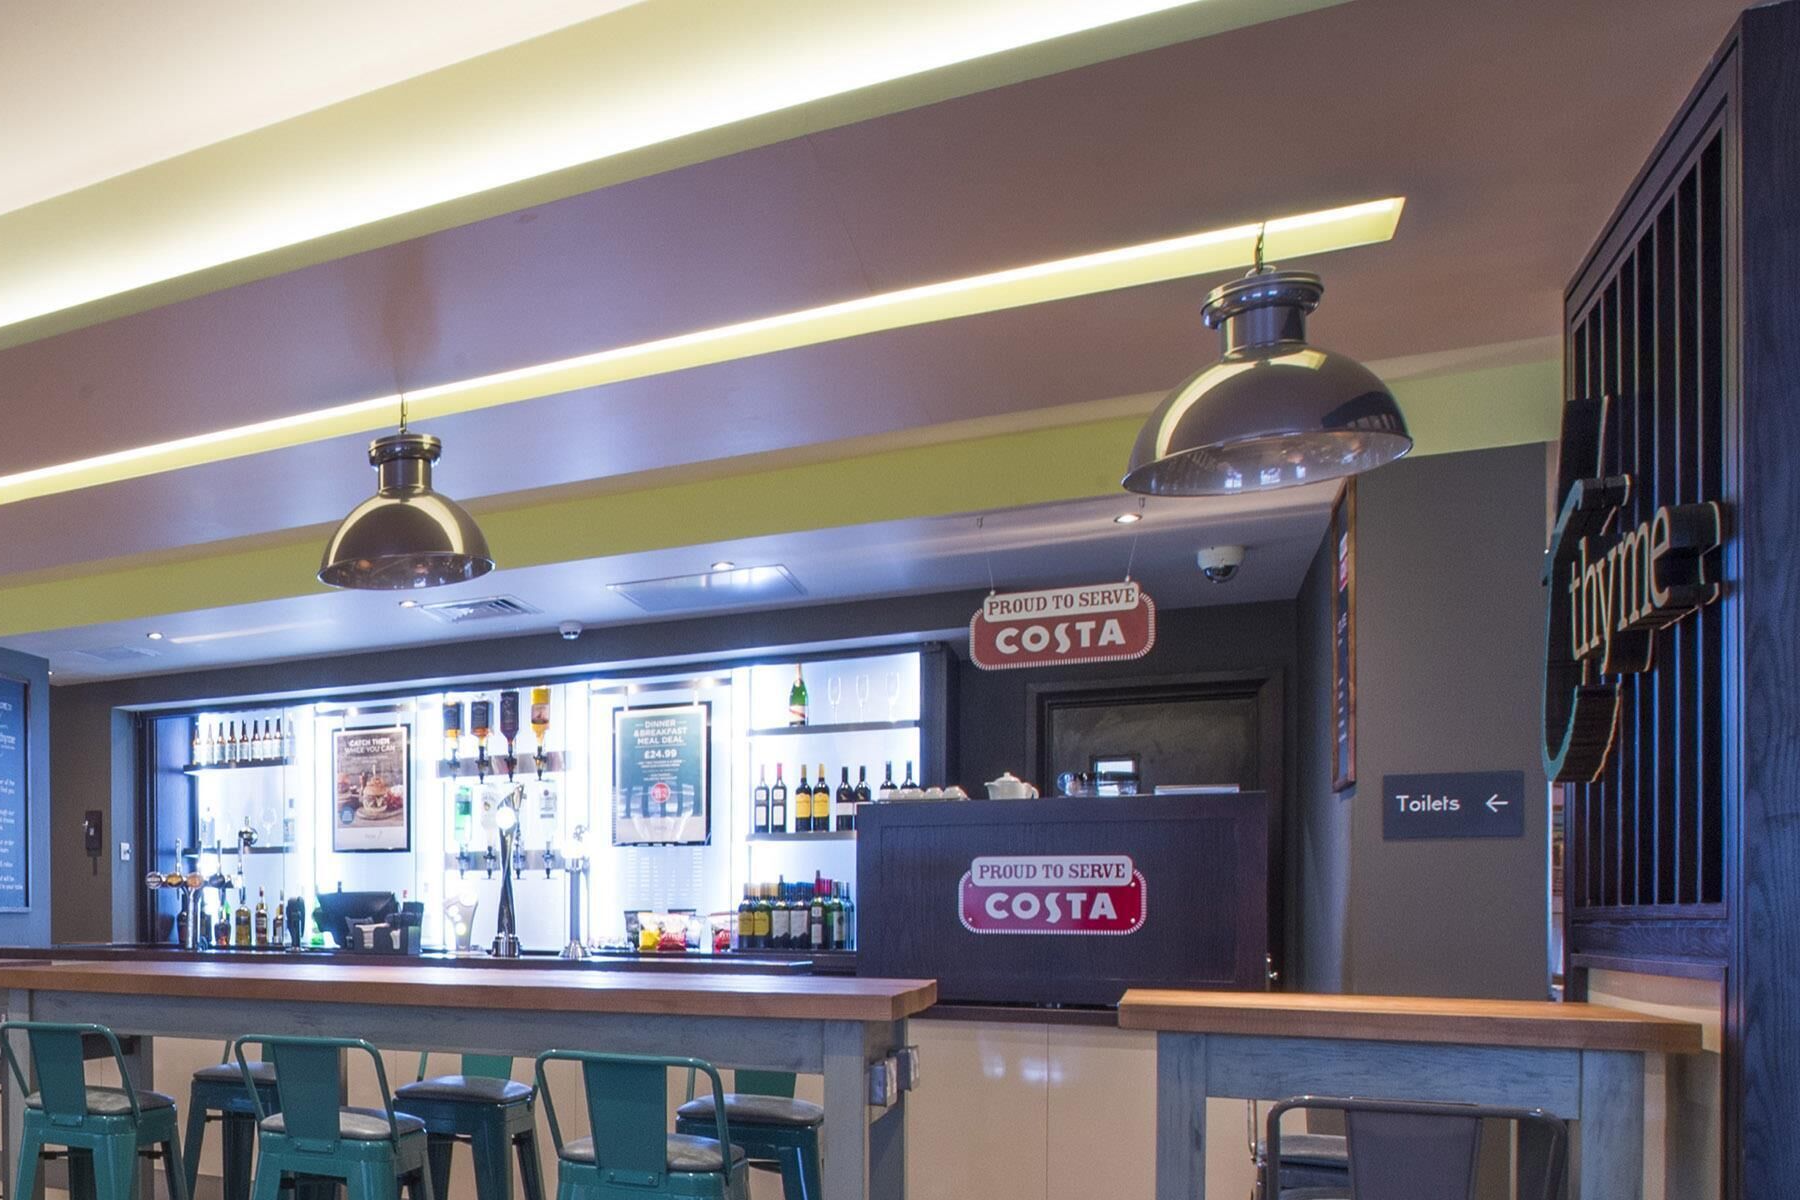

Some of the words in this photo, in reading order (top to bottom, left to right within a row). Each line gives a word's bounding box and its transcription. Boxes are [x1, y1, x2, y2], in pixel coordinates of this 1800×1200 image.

[1568, 505, 1672, 676] thyme
[988, 596, 1048, 616] PROUD
[1052, 593, 1074, 609] TO
[1079, 588, 1135, 607] SERVE
[995, 619, 1126, 654] COSTA
[644, 719, 676, 729] DINNER
[349, 739, 371, 747] CATCH
[637, 736, 660, 745] MEAL
[661, 735, 684, 744] DEAL
[366, 745, 380, 753] YOU
[644, 748, 678, 759] £24.99
[1396, 794, 1461, 812] Toilets
[979, 864, 1037, 879] PROUD
[1042, 864, 1064, 879] TO
[1068, 863, 1126, 879] SERVE
[985, 892, 1118, 924] COSTA
